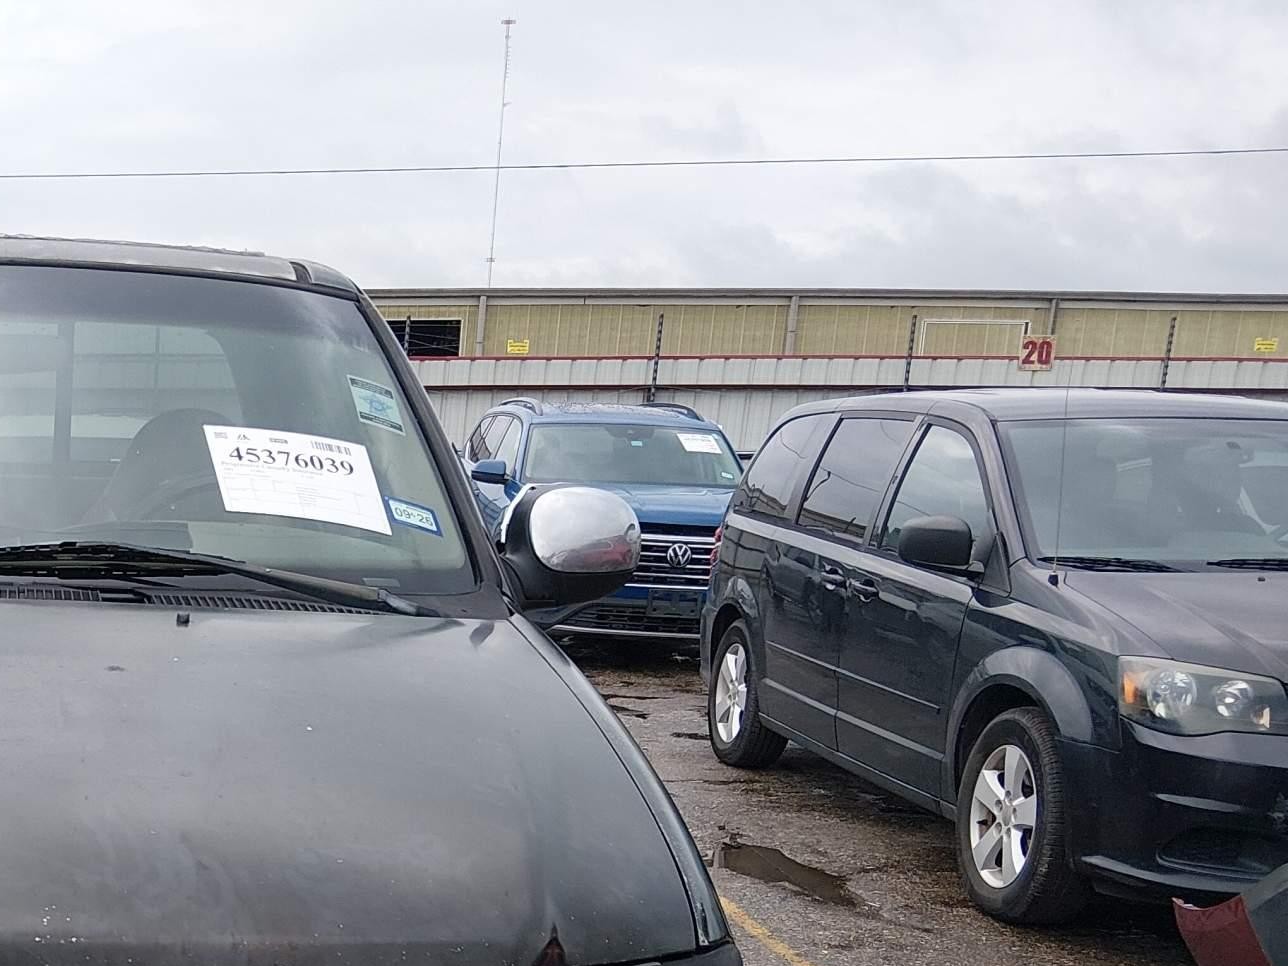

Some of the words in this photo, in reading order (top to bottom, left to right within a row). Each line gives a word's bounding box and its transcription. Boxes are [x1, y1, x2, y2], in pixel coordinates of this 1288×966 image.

[1022, 340, 1053, 365] 20
[229, 446, 355, 476] 45376039
[394, 507, 411, 519] 09
